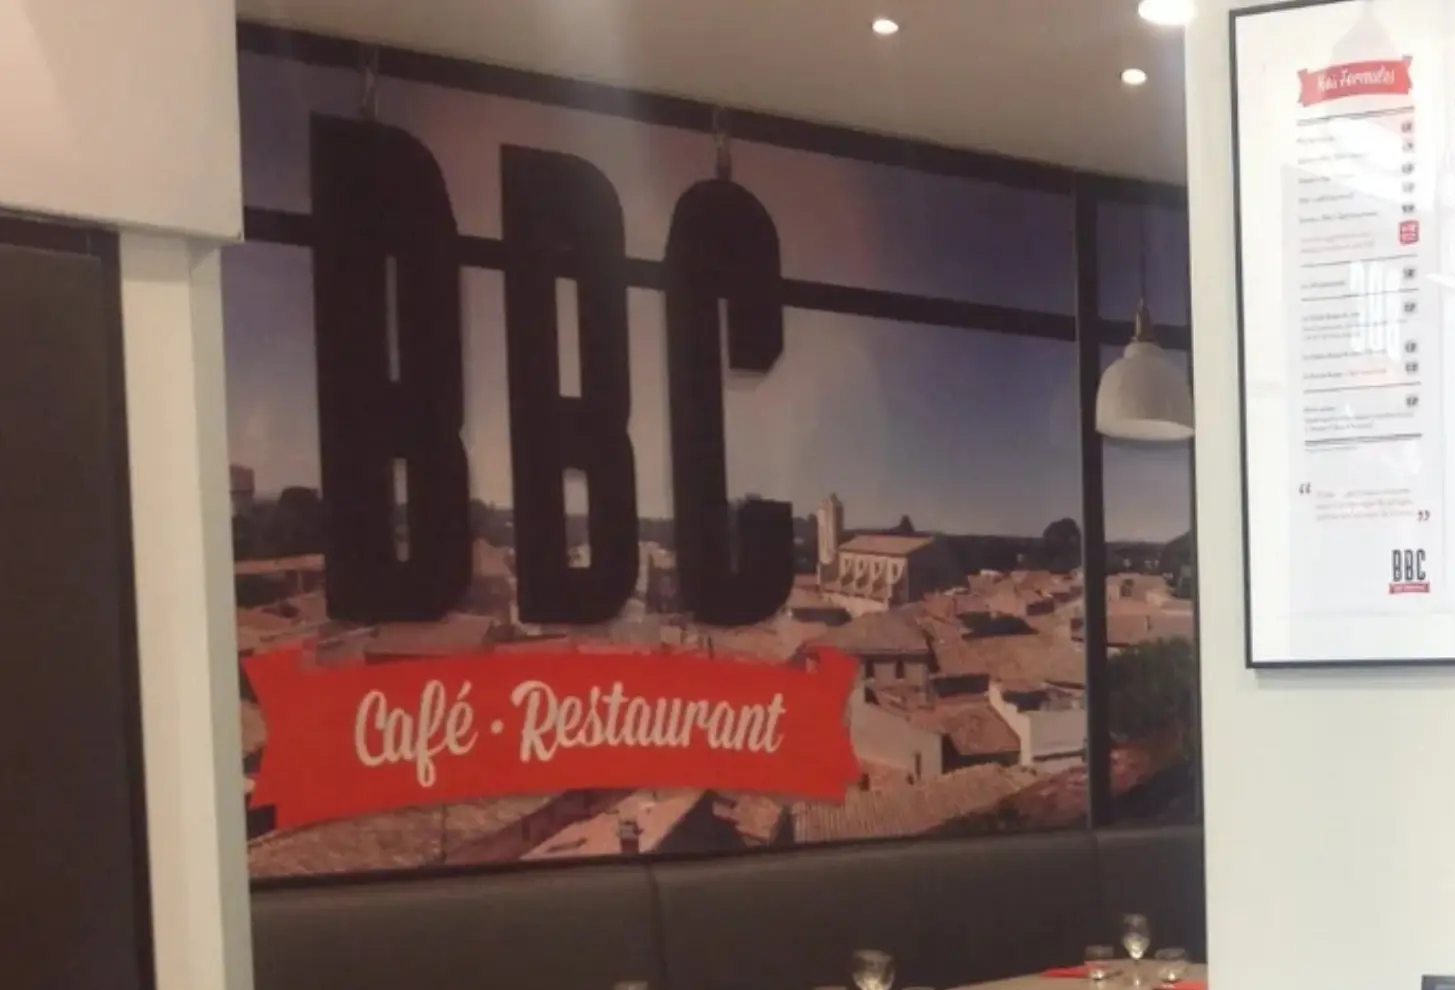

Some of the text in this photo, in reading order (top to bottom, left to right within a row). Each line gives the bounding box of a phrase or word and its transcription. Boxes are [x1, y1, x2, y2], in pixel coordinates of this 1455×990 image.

[309, 111, 795, 626] BBC
[1391, 548, 1427, 581] BBC
[355, 679, 786, 787] Café Restaurant
